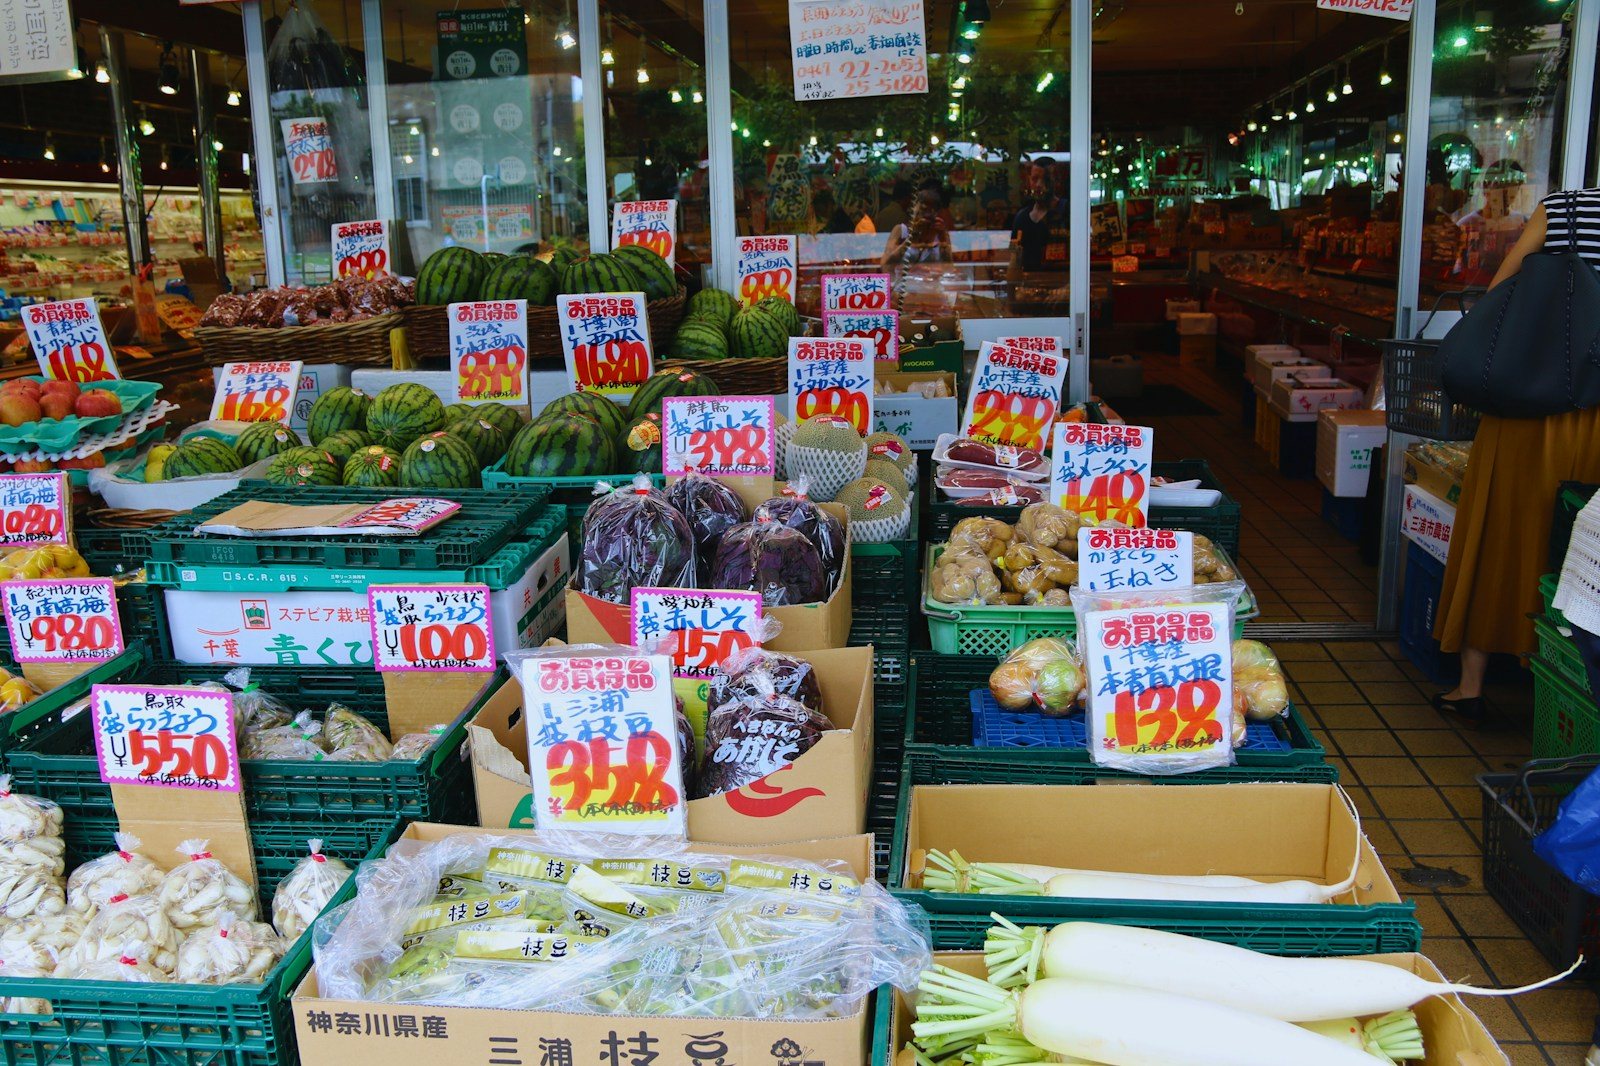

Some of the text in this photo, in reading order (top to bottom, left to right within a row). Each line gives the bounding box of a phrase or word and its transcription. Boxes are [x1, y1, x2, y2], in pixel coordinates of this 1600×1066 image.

[294, 148, 337, 181] 278
[621, 201, 668, 213] お買得品
[742, 238, 789, 252] お買得品
[30, 303, 90, 324] お買得品
[458, 303, 518, 321] お買得品
[568, 298, 636, 318] お買得品
[797, 341, 864, 360] お買得品
[989, 346, 1057, 376] お買得品
[230, 362, 291, 375] お買得品
[459, 345, 525, 397] 899
[222, 387, 290, 422] 168
[694, 409, 765, 433] 赤しそ
[1065, 424, 1142, 447] お買得品
[1065, 468, 1145, 528] 148
[1090, 529, 1177, 549] お買得品
[1410, 515, 1451, 543] 三浦市農協
[1088, 550, 1156, 565] かまくら
[235, 573, 273, 582] S.C.R.
[279, 574, 297, 582] 615
[1099, 554, 1179, 590] 玉ねぎ
[26, 584, 105, 600] 紀州みなべ
[36, 595, 109, 616] 南高梅
[278, 607, 371, 623] ステビア栽培
[664, 605, 748, 632] 赤しそ
[1102, 612, 1216, 647] お買得品
[203, 638, 241, 659] 千葉
[539, 657, 656, 692] お買得品
[145, 691, 186, 710] 鳥取
[567, 690, 628, 717] 三浦
[127, 707, 218, 735] らっきょう
[1114, 677, 1223, 748] 138
[576, 711, 656, 742] 枝豆
[733, 719, 801, 739] へきなんの
[546, 730, 680, 811] 358
[496, 850, 540, 864] 神奈川県産
[601, 860, 693, 886] 神奈川県産 枝豆
[789, 871, 834, 892] 枝豆
[448, 901, 490, 922] 枝豆
[521, 937, 568, 959] 枝豆
[306, 1010, 449, 1039] 神奈川県産
